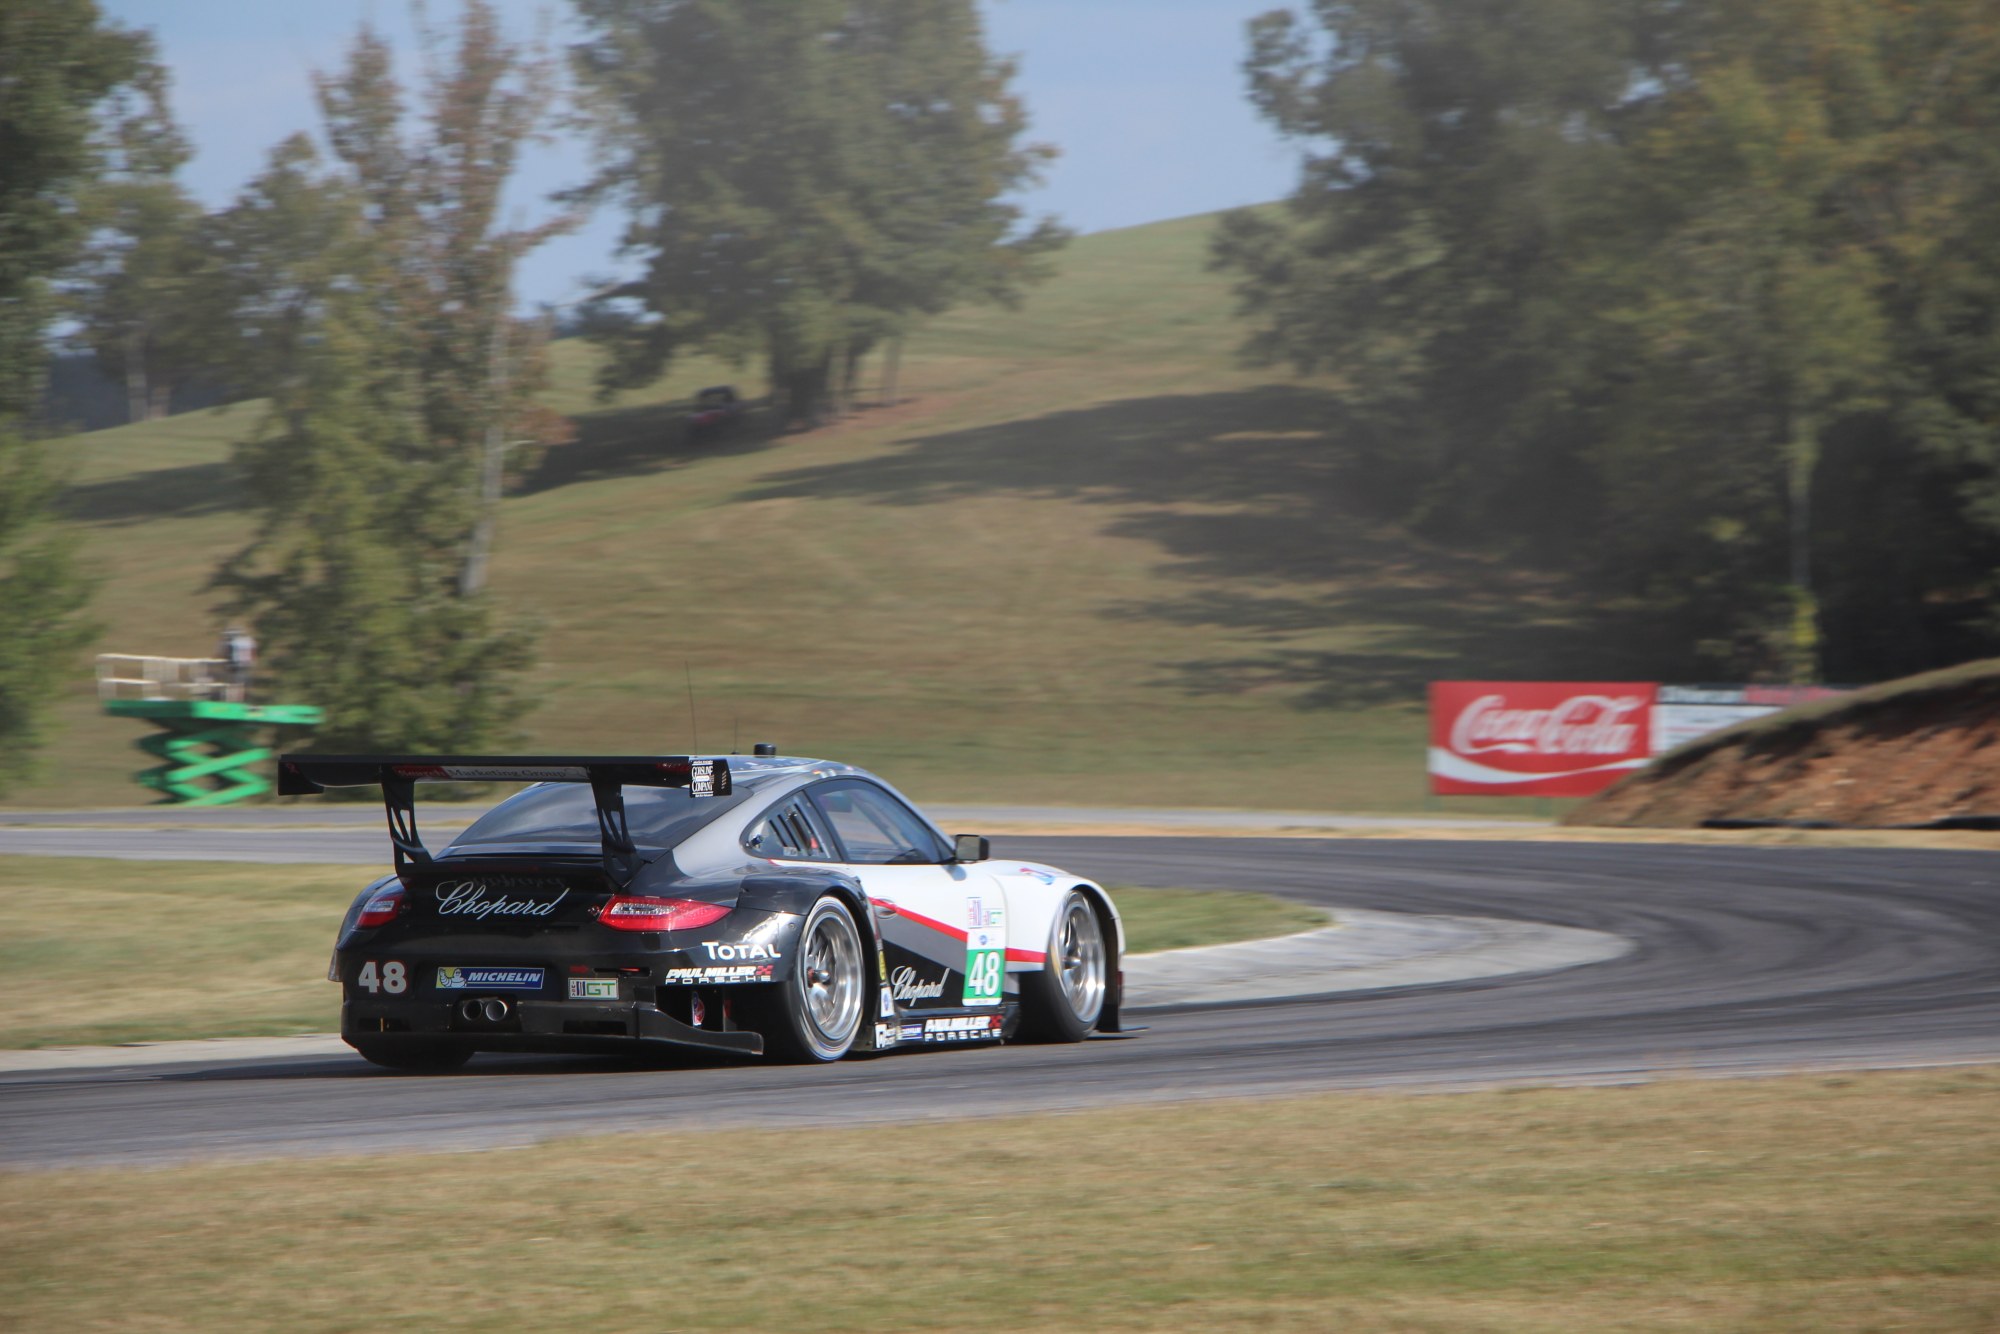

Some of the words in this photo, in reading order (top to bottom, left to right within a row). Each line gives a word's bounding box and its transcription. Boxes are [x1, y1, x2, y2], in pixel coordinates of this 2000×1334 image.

[448, 768, 520, 778] Marketing
[522, 769, 566, 778] Group
[436, 881, 570, 920] Chopard
[358, 961, 407, 994] 48
[468, 972, 541, 982] MICHELIN
[666, 968, 704, 979] PAUL
[704, 966, 757, 977] MILLER
[968, 951, 1001, 997] 48
[665, 975, 771, 985] PORSCHE
[891, 966, 950, 1007] Chopard
[586, 983, 615, 995] GT
[925, 1028, 1002, 1042] PORSCHE
